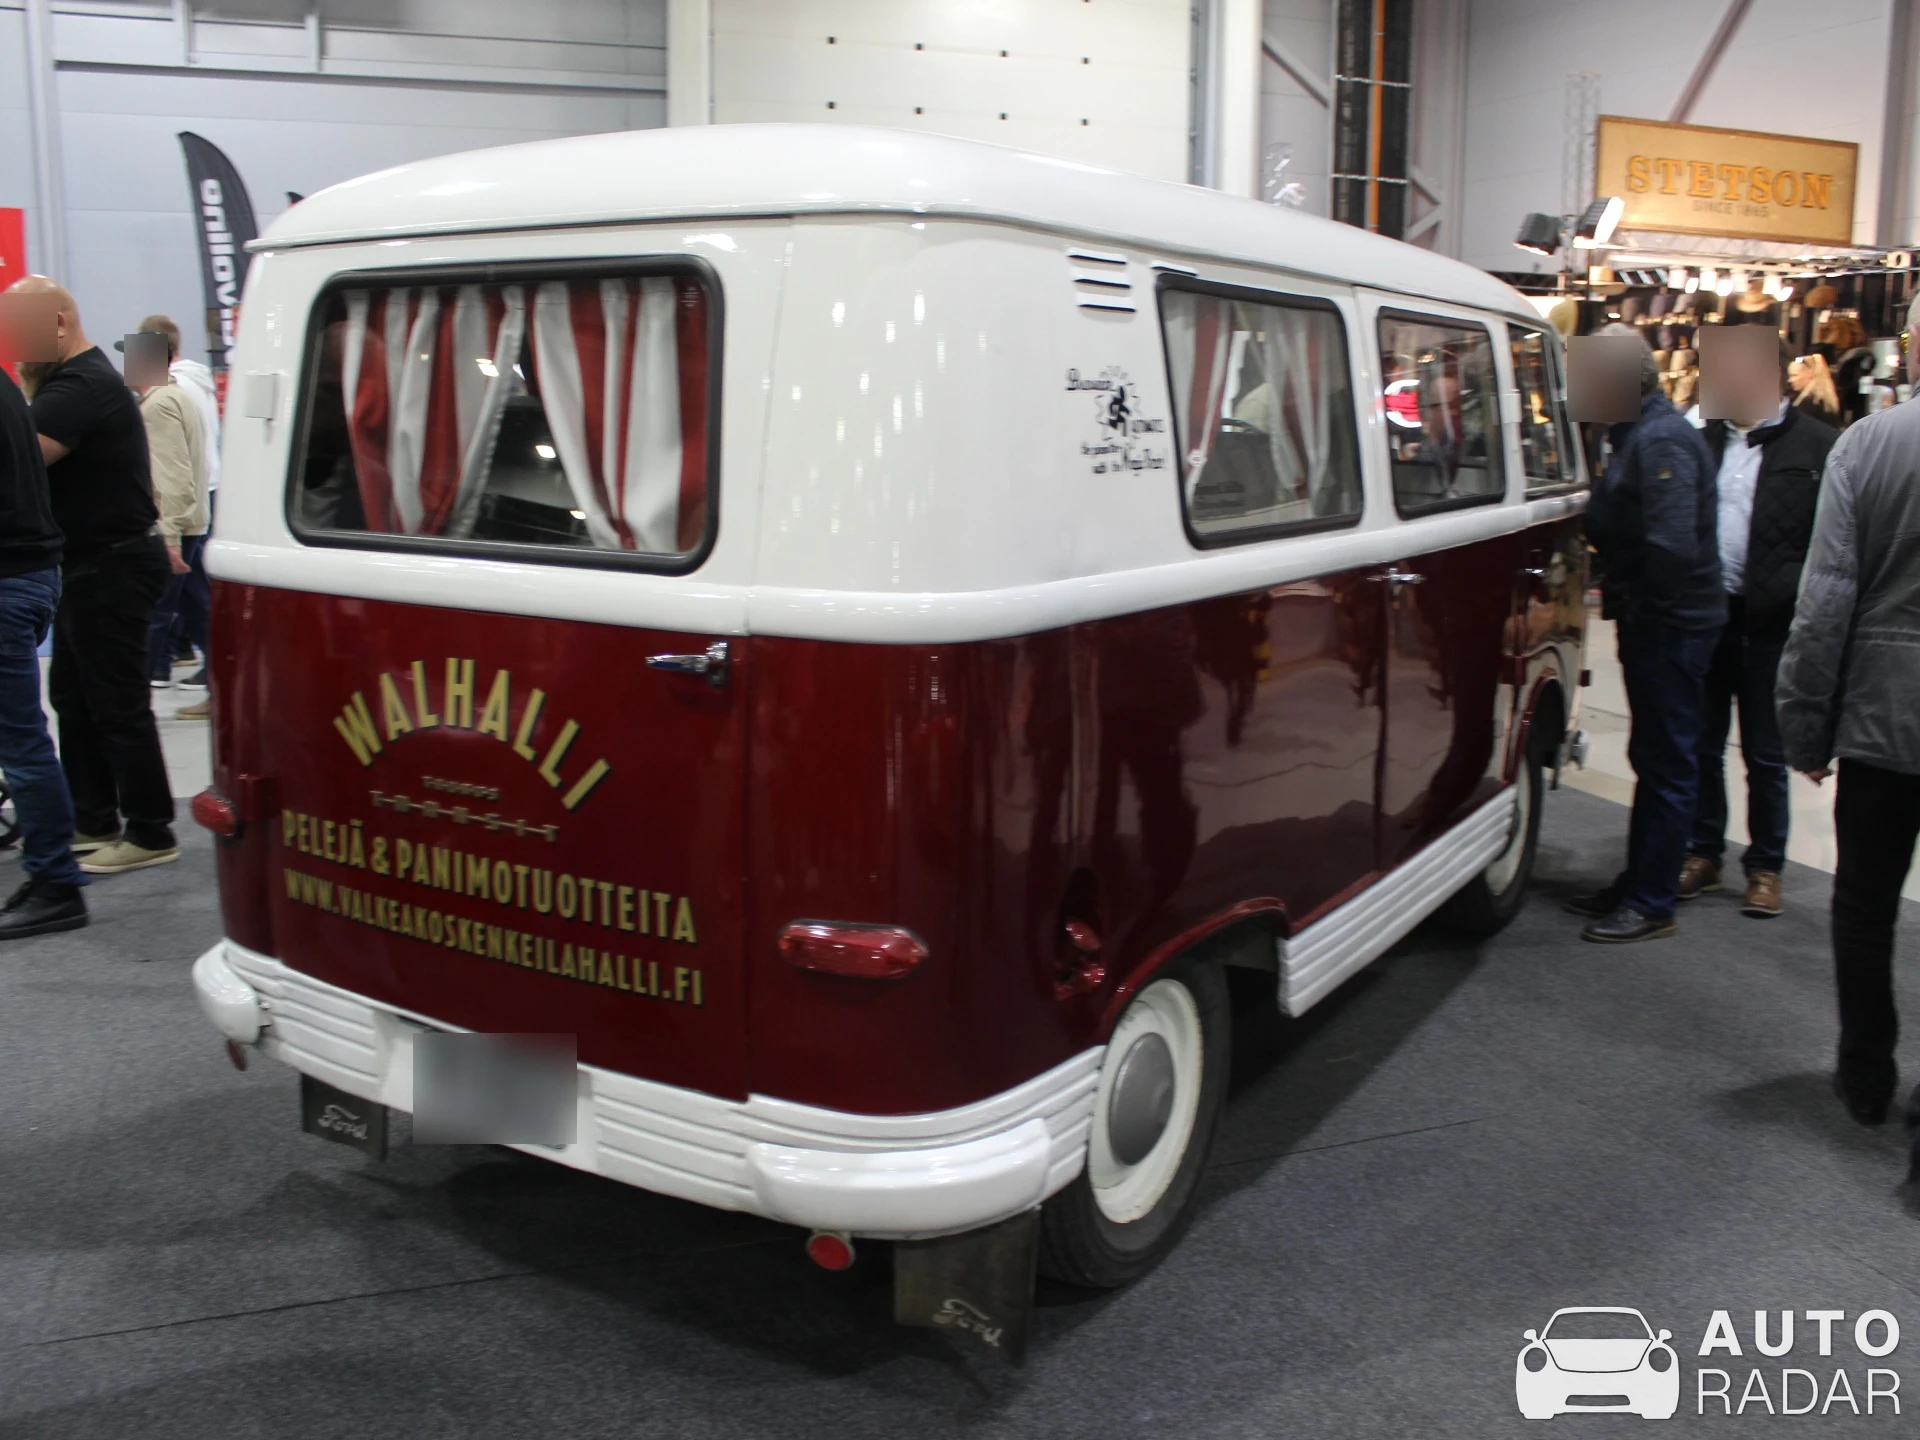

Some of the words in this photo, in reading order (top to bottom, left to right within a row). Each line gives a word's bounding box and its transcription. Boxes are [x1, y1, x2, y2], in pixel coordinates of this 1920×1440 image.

[1625, 154, 1834, 210] STETSON
[1692, 199, 1733, 215] SINCE
[333, 657, 612, 811] WALHALLI
[282, 809, 366, 869] PELEJÄ
[370, 836, 391, 875] &
[396, 838, 698, 944] PANIMOTUOTTEITA
[284, 867, 704, 1005] WWW.VALKEAKOSKENKEILAHALLI.FI
